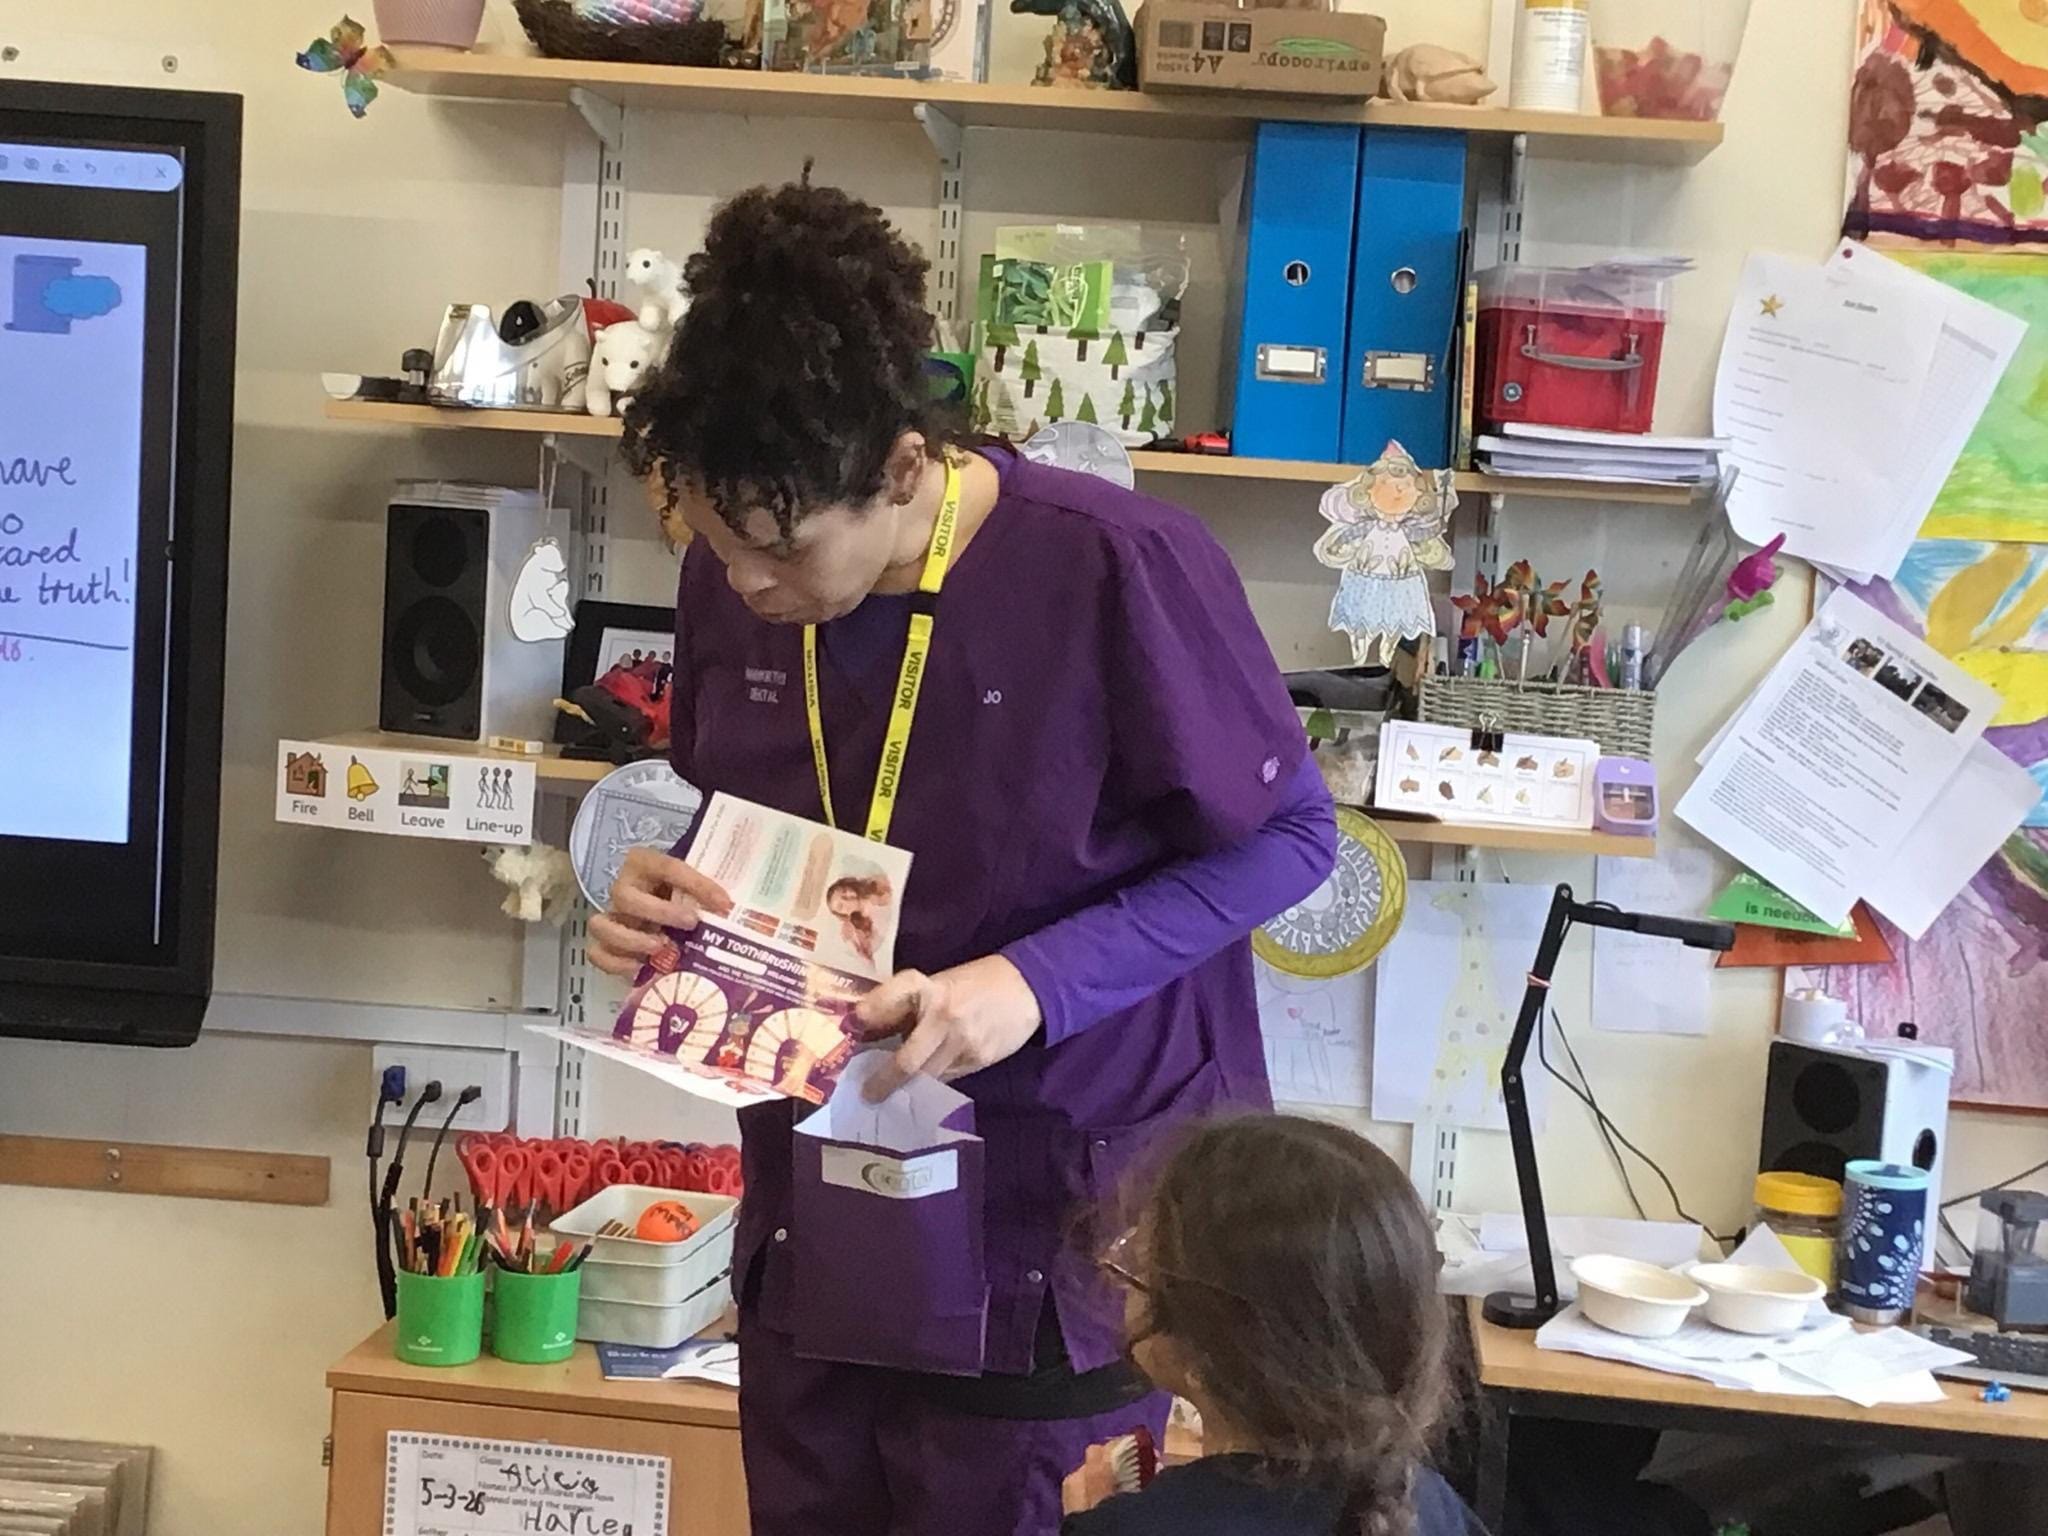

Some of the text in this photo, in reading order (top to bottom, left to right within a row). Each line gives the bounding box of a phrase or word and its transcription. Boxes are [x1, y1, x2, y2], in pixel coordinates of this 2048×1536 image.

[1192, 51, 1224, 74] A4
[1252, 51, 1371, 72] envirocopy
[933, 500, 957, 559] VISITOR
[38, 557, 130, 605] truth!
[898, 651, 923, 710] VISITOR
[983, 689, 1003, 704] JO
[878, 740, 903, 799] VISITOR
[292, 800, 318, 816] Fire
[347, 807, 375, 823] Bell
[401, 812, 446, 829] Leave
[465, 818, 524, 838] Line-up
[1745, 902, 1759, 915] is
[702, 929, 725, 946] MY
[727, 939, 808, 977] TOOTHBRUSHIN
